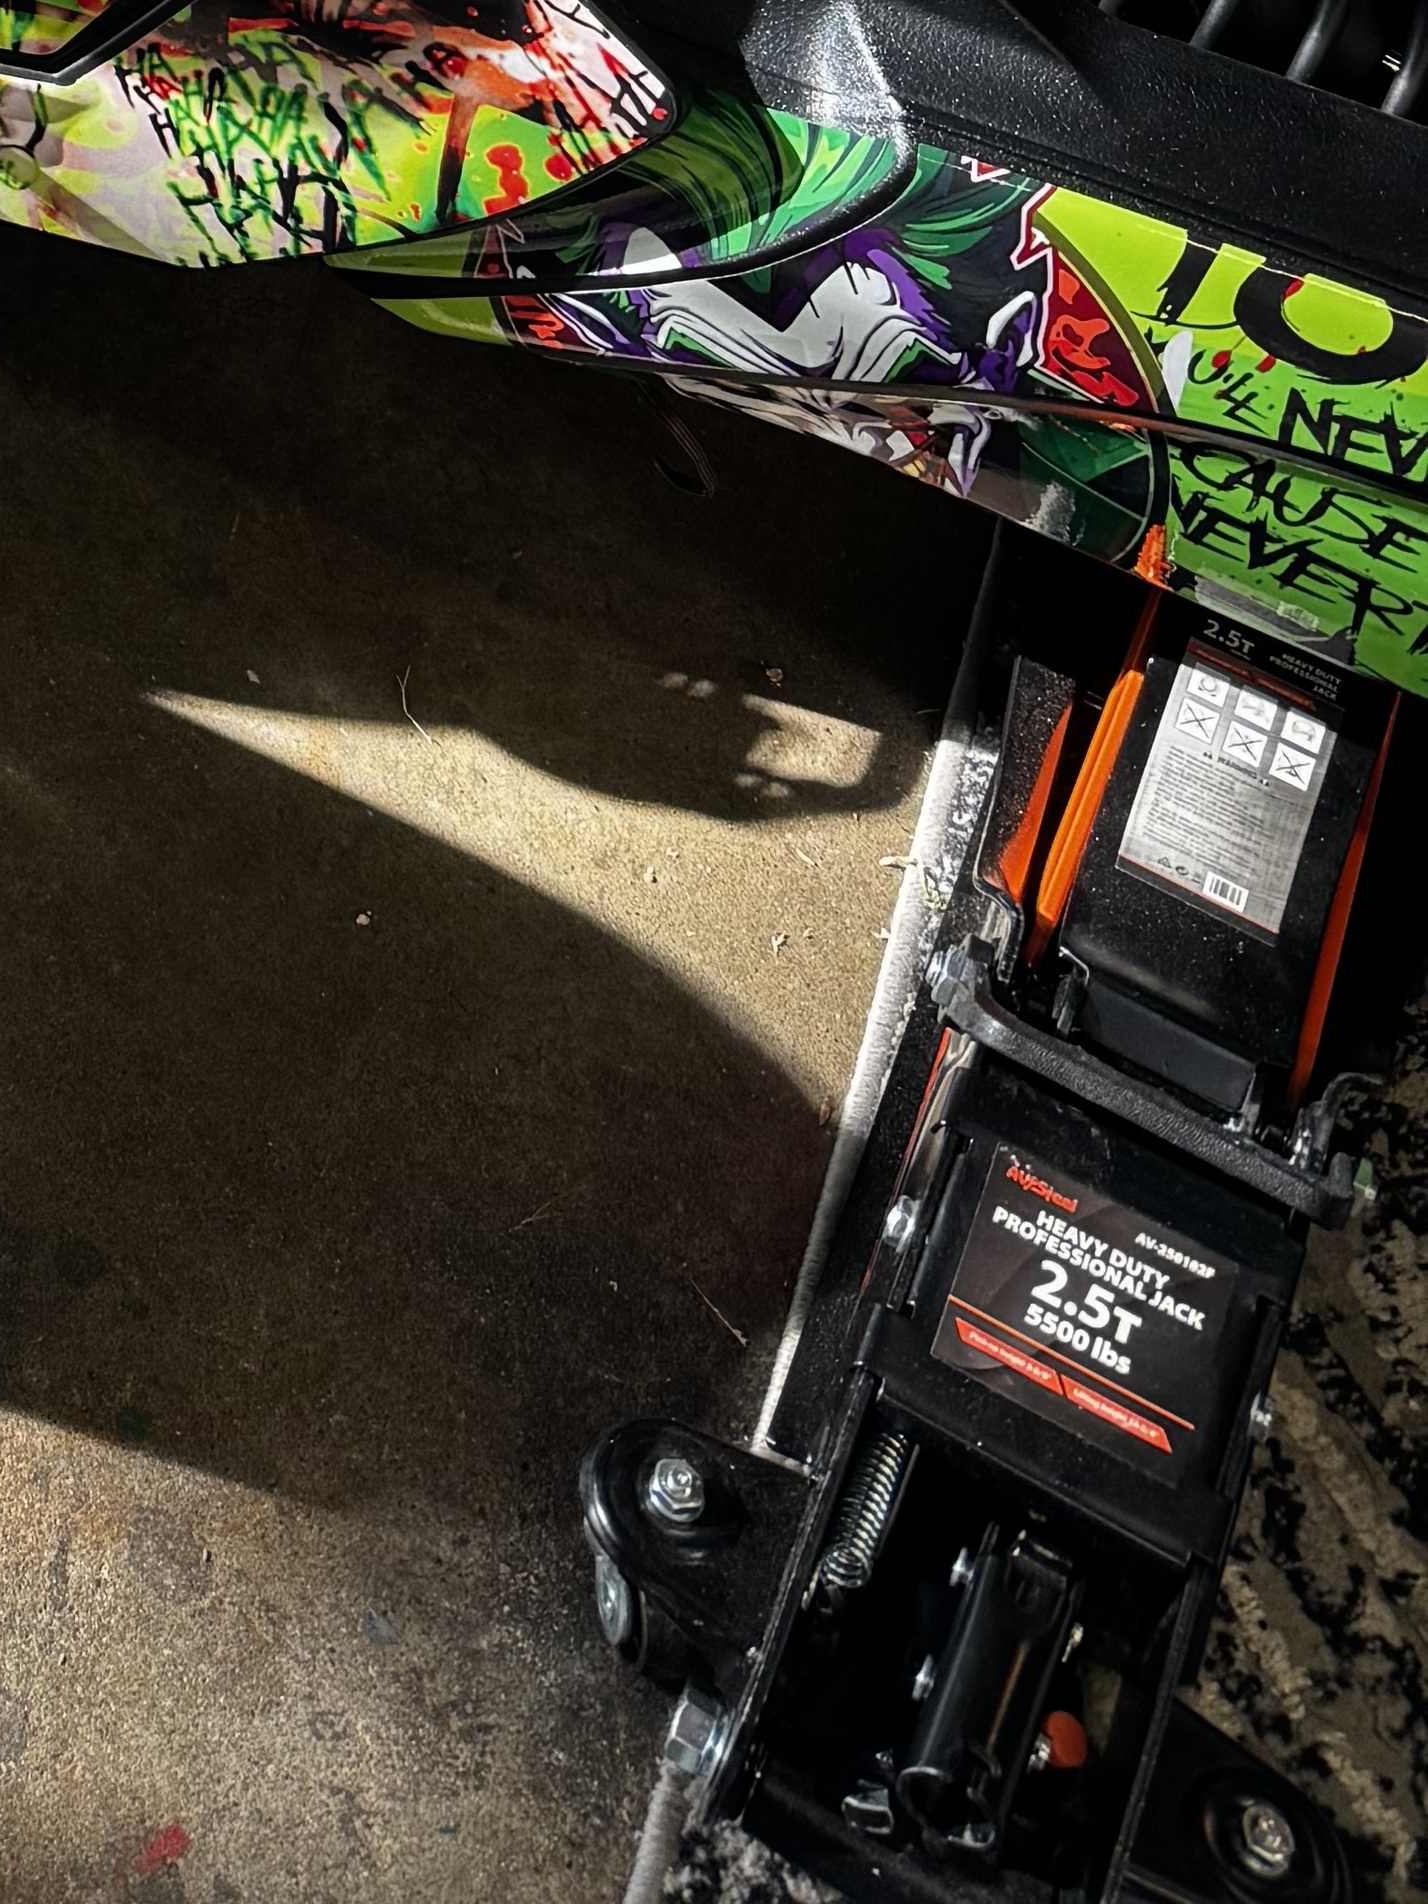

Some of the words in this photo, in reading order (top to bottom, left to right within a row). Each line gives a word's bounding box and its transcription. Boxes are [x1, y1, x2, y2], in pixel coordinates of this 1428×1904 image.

[1202, 619, 1256, 658] 2.5T
[992, 1206, 1148, 1302] PROFESSIONAL
[1147, 1291, 1207, 1332] JACK
[1036, 1210, 1109, 1258] HEAVY
[1109, 1248, 1172, 1290] DUTY
[1023, 1303, 1091, 1352] 5500
[1093, 1335, 1133, 1376] lbs
[1030, 1259, 1144, 1344] 2.5T
